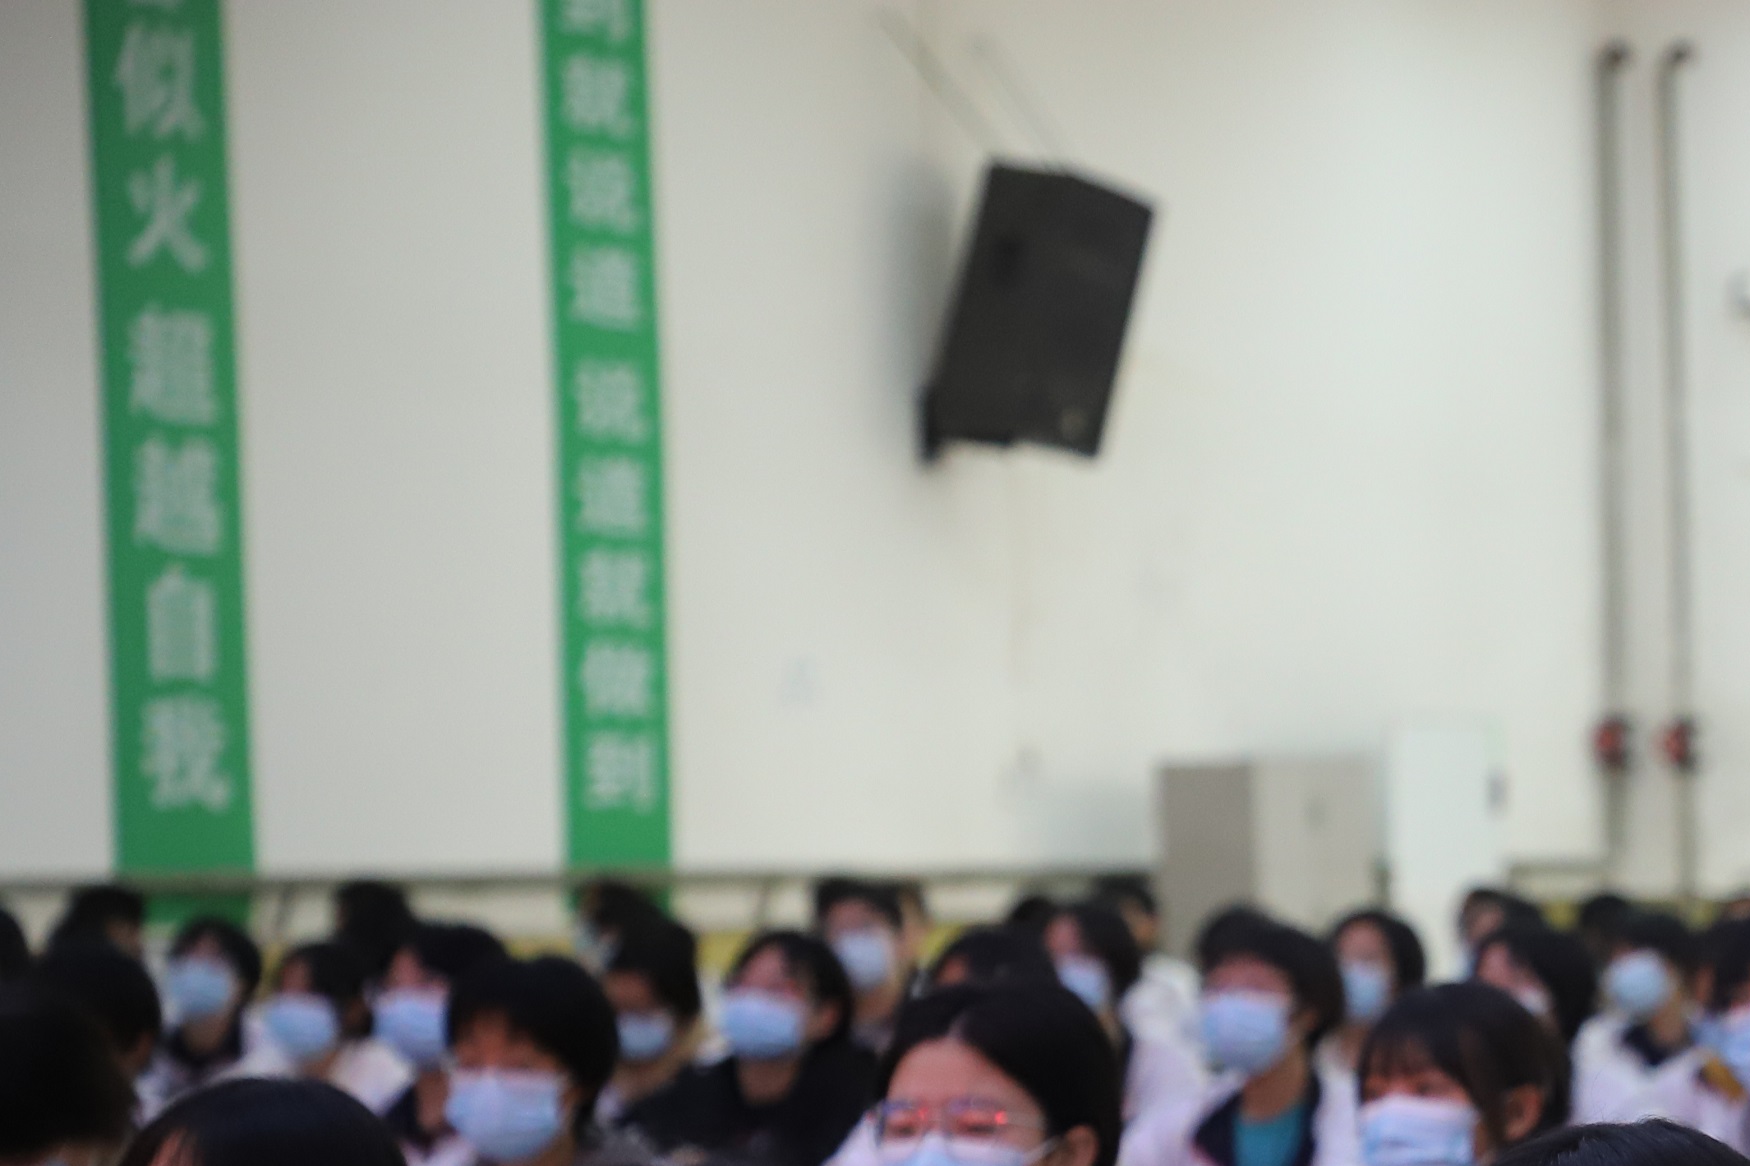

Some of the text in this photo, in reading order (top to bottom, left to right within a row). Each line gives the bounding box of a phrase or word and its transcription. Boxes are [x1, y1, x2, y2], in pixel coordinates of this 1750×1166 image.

[115, 0, 232, 812] 似火 超越自我
